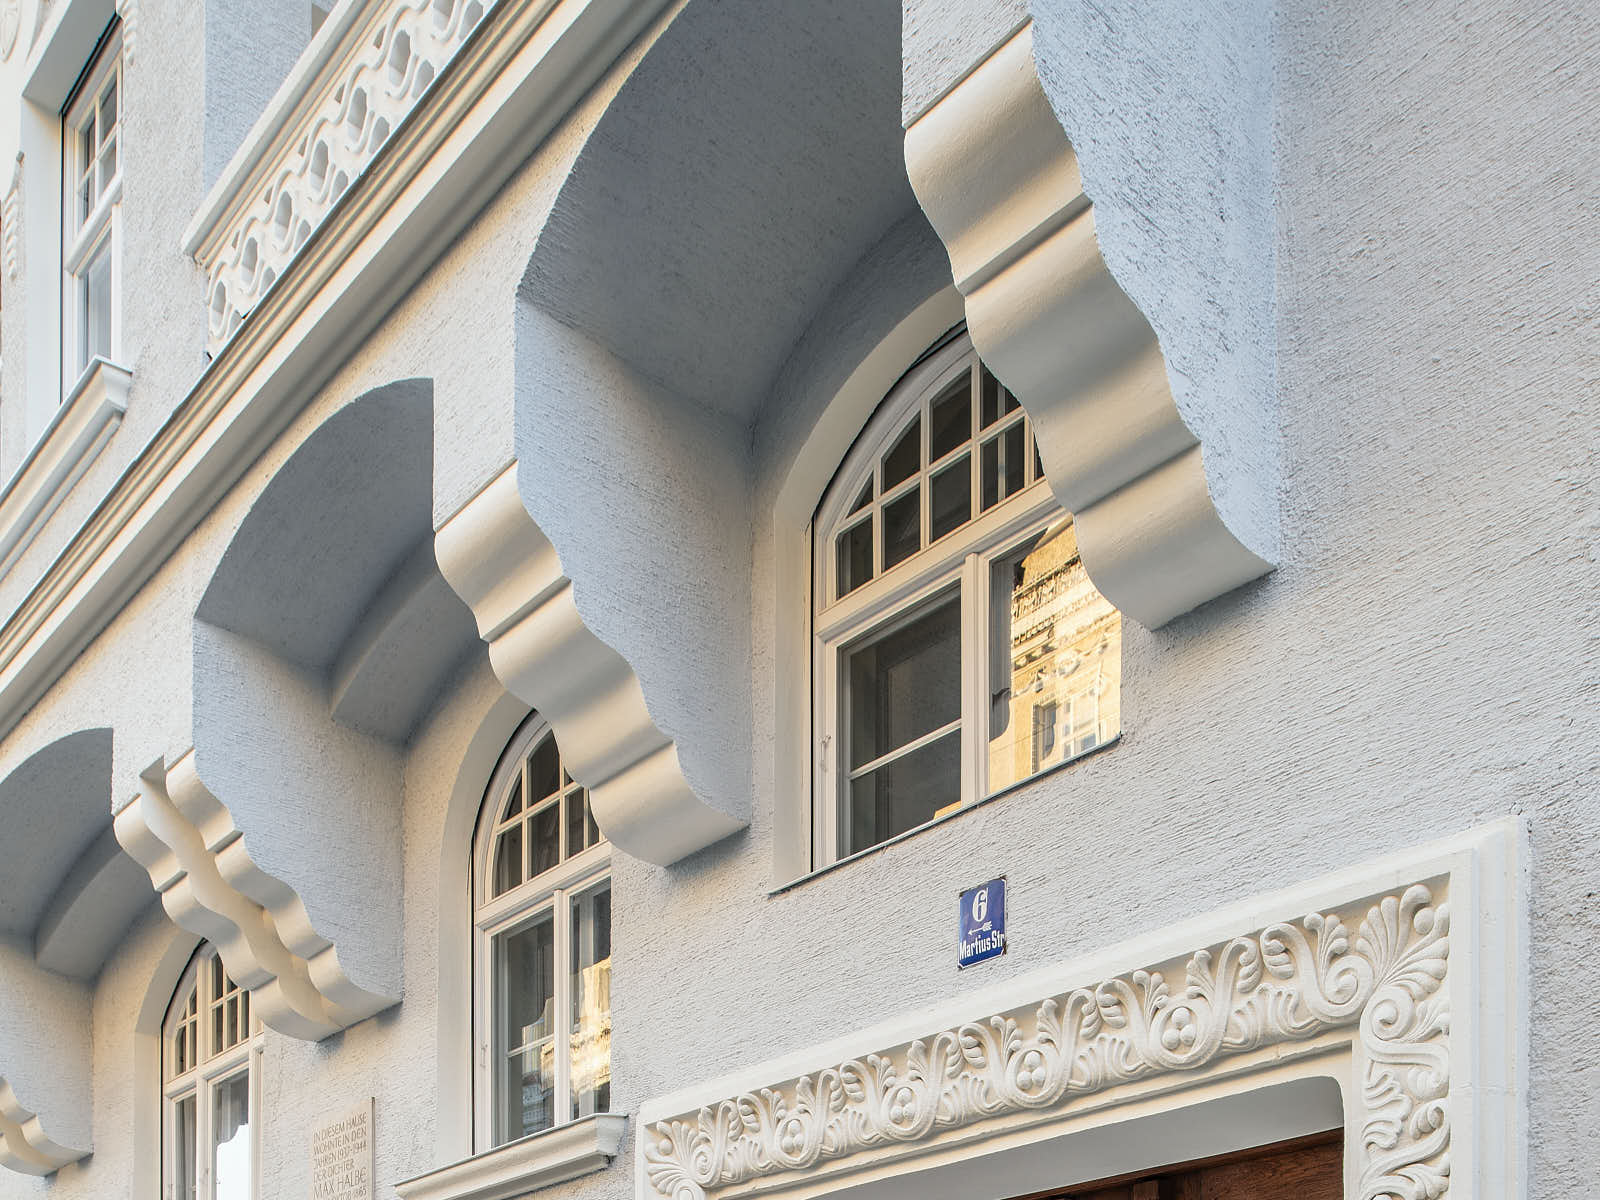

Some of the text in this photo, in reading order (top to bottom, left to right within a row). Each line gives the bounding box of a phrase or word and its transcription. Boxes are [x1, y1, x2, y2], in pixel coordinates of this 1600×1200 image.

[972, 887, 989, 922] 6
[959, 934, 991, 961] Martius
[351, 1126, 367, 1142] DEN
[313, 1167, 367, 1199] MAX HALBE
